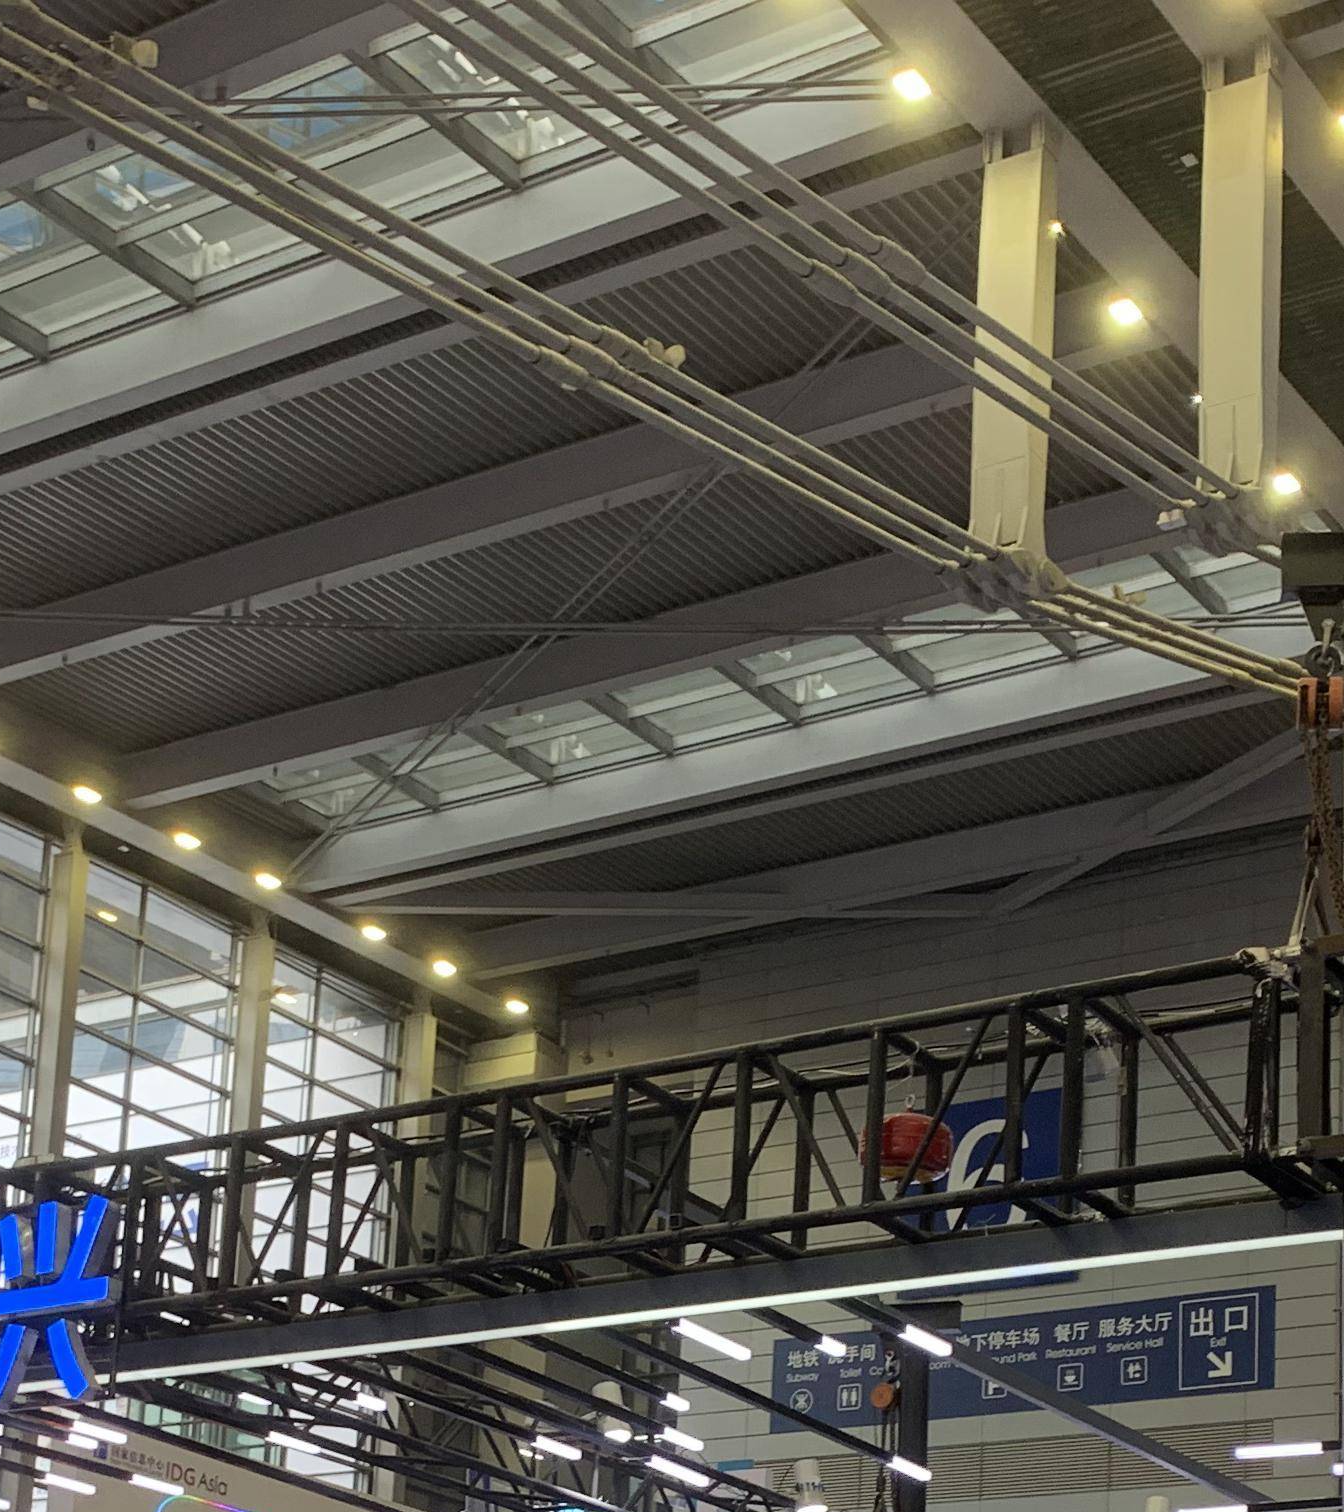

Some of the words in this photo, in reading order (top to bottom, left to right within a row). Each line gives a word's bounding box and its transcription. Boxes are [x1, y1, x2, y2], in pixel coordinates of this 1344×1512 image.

[785, 1372, 819, 1383] Subway
[839, 1367, 862, 1379] Toilet
[1017, 1351, 1038, 1362] Park
[1045, 1345, 1097, 1359] Restaurant
[1106, 1340, 1143, 1354] Service
[1145, 1336, 1164, 1349] Hall
[1210, 1336, 1227, 1348] Exit
[787, 1348, 820, 1369] 地铁
[1053, 1321, 1089, 1343] 餐厅
[1097, 1311, 1172, 1338] 服务大厅
[1189, 1305, 1249, 1338] 出口
[165, 1462, 196, 1486] IDG
[197, 1473, 228, 1496] Asia
